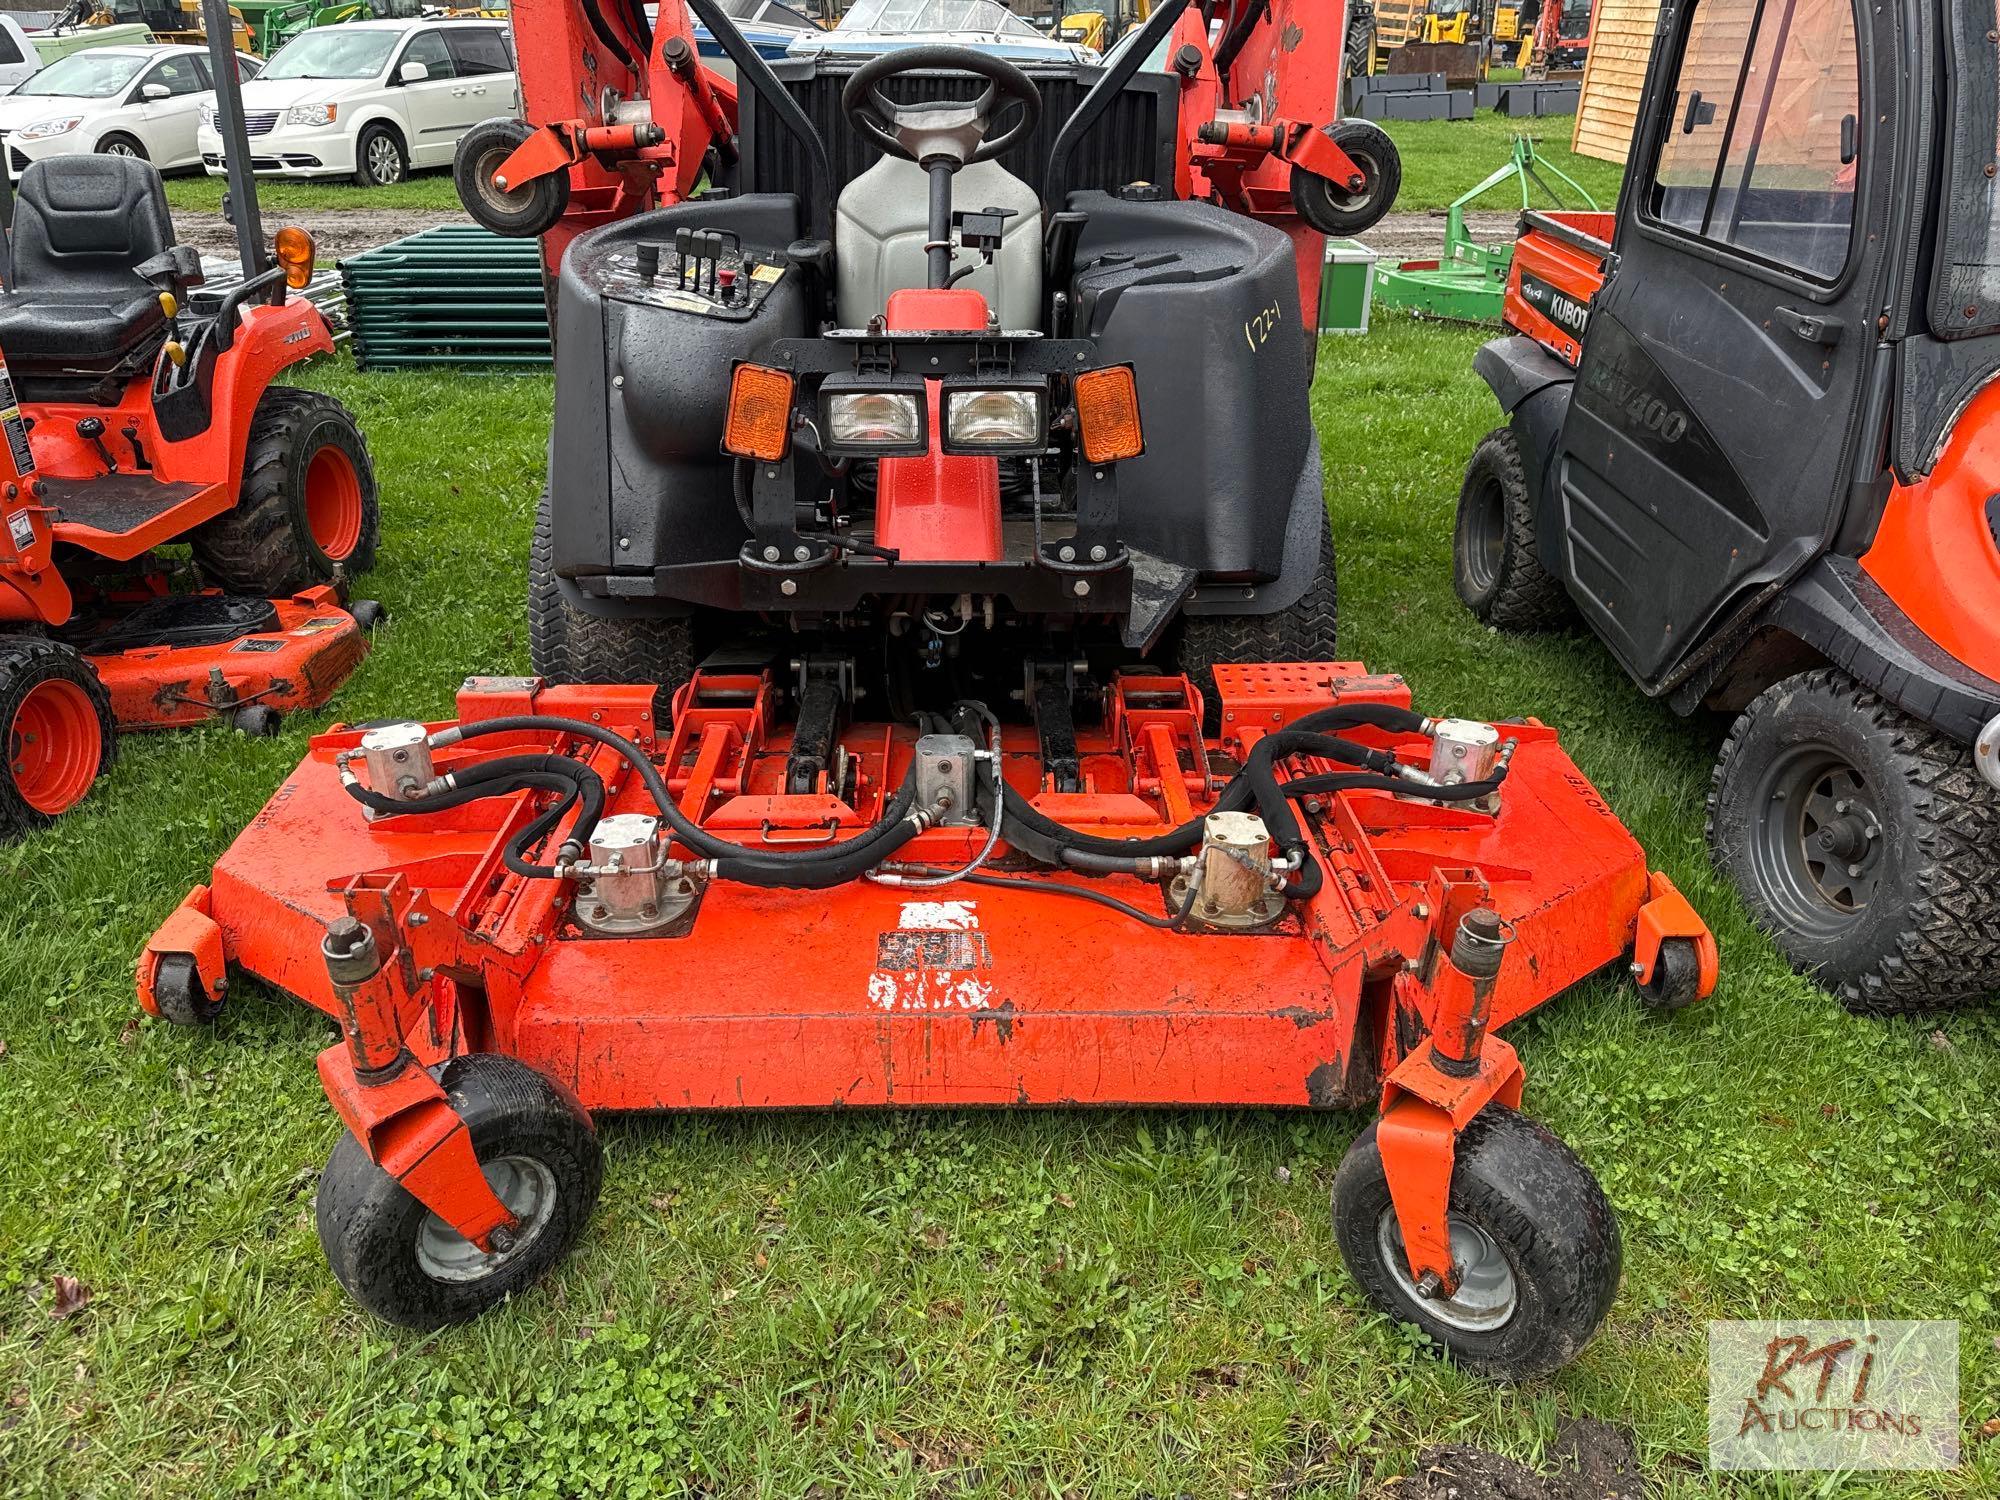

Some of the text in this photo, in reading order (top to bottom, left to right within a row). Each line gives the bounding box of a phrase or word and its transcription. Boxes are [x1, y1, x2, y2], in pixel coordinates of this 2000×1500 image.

[1523, 283, 1543, 300] 4x4
[1245, 298, 1281, 353] 122-1
[275, 784, 298, 801] NO
